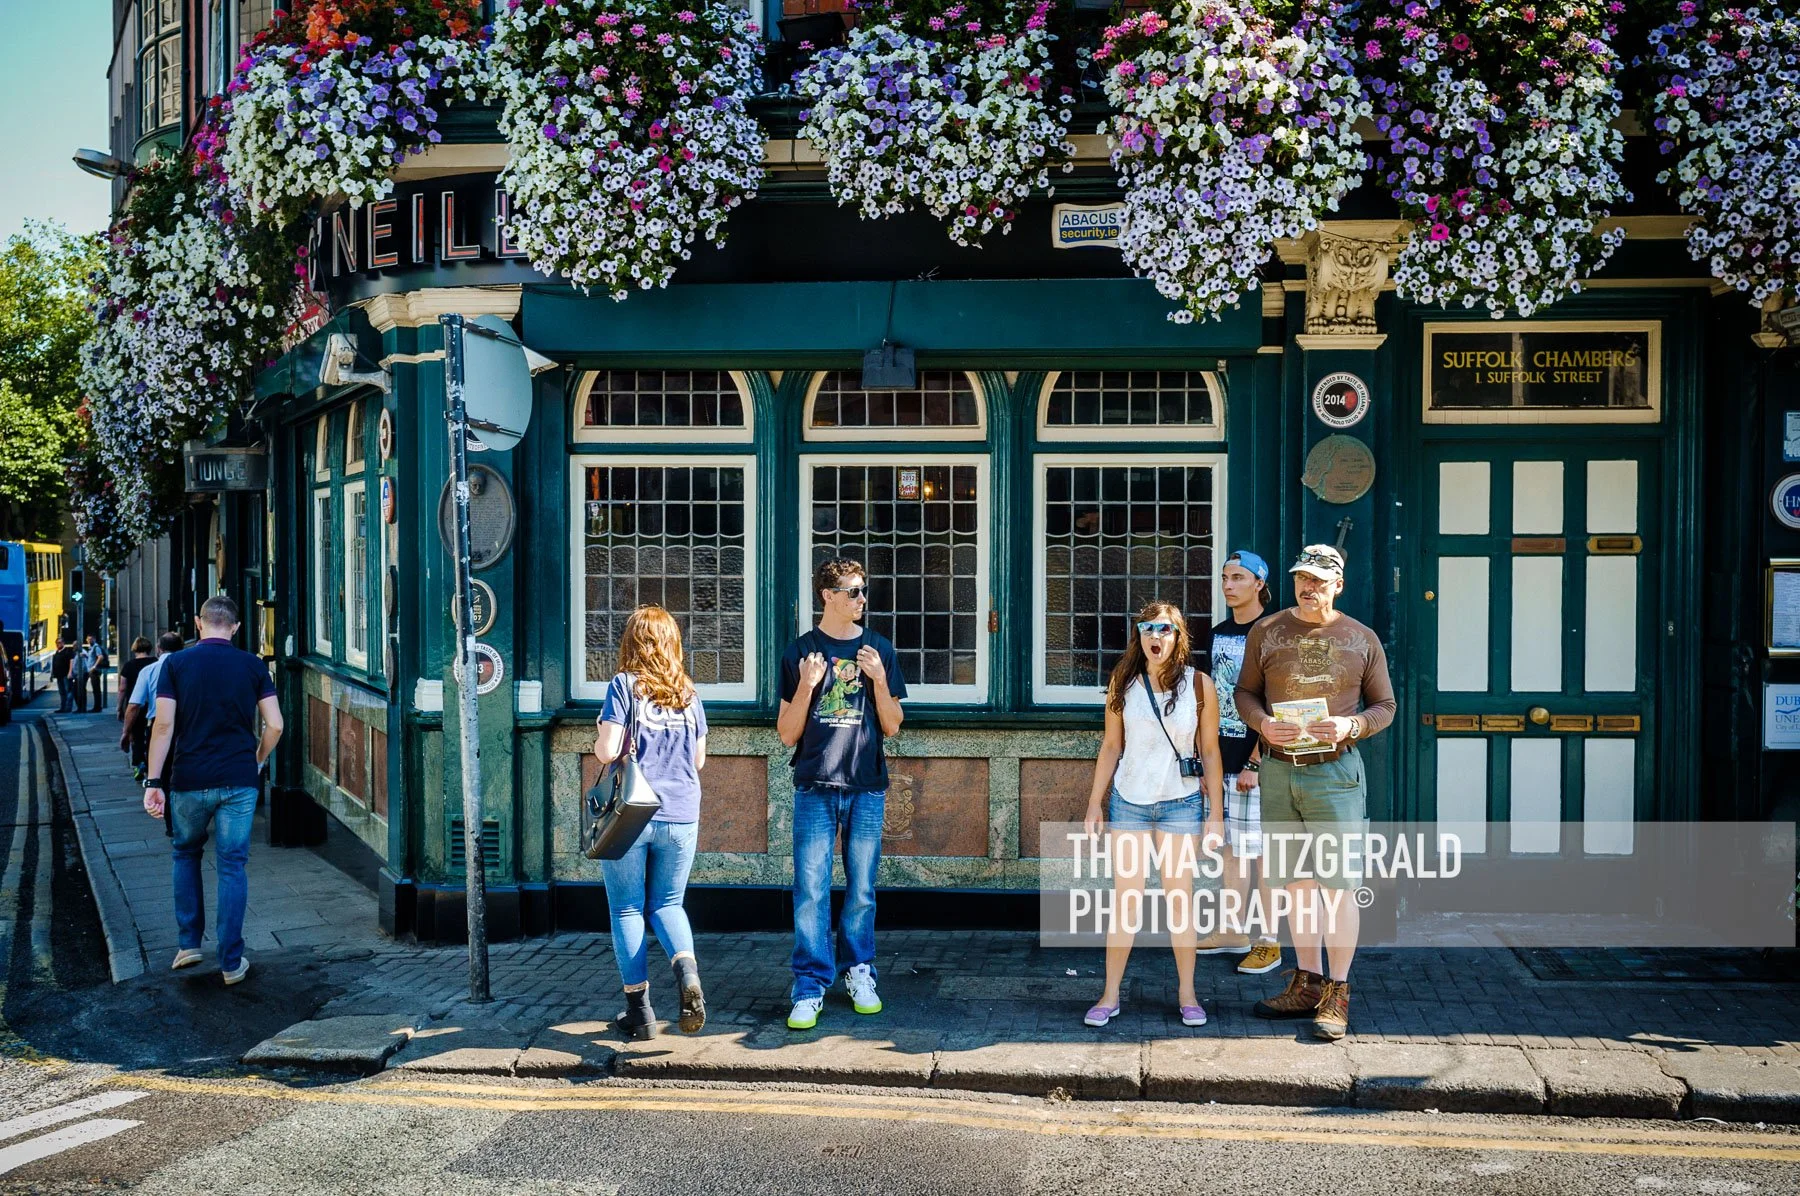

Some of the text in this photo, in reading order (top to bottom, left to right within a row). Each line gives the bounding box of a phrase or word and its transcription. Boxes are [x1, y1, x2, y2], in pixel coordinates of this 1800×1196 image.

[1062, 213, 1117, 226] ABACUS
[1061, 227, 1118, 239] security.ie
[1443, 350, 1636, 368] SUFFOLK CHAMBERS
[1487, 371, 1546, 383] SUFFOLK
[1553, 371, 1603, 383] STREET
[1316, 376, 1336, 409] RECOMMENDED
[1345, 376, 1358, 385] TASTE
[1324, 394, 1346, 406] 2014
[1321, 413, 1331, 422] WITH
[1300, 657, 1331, 666] TABASCO
